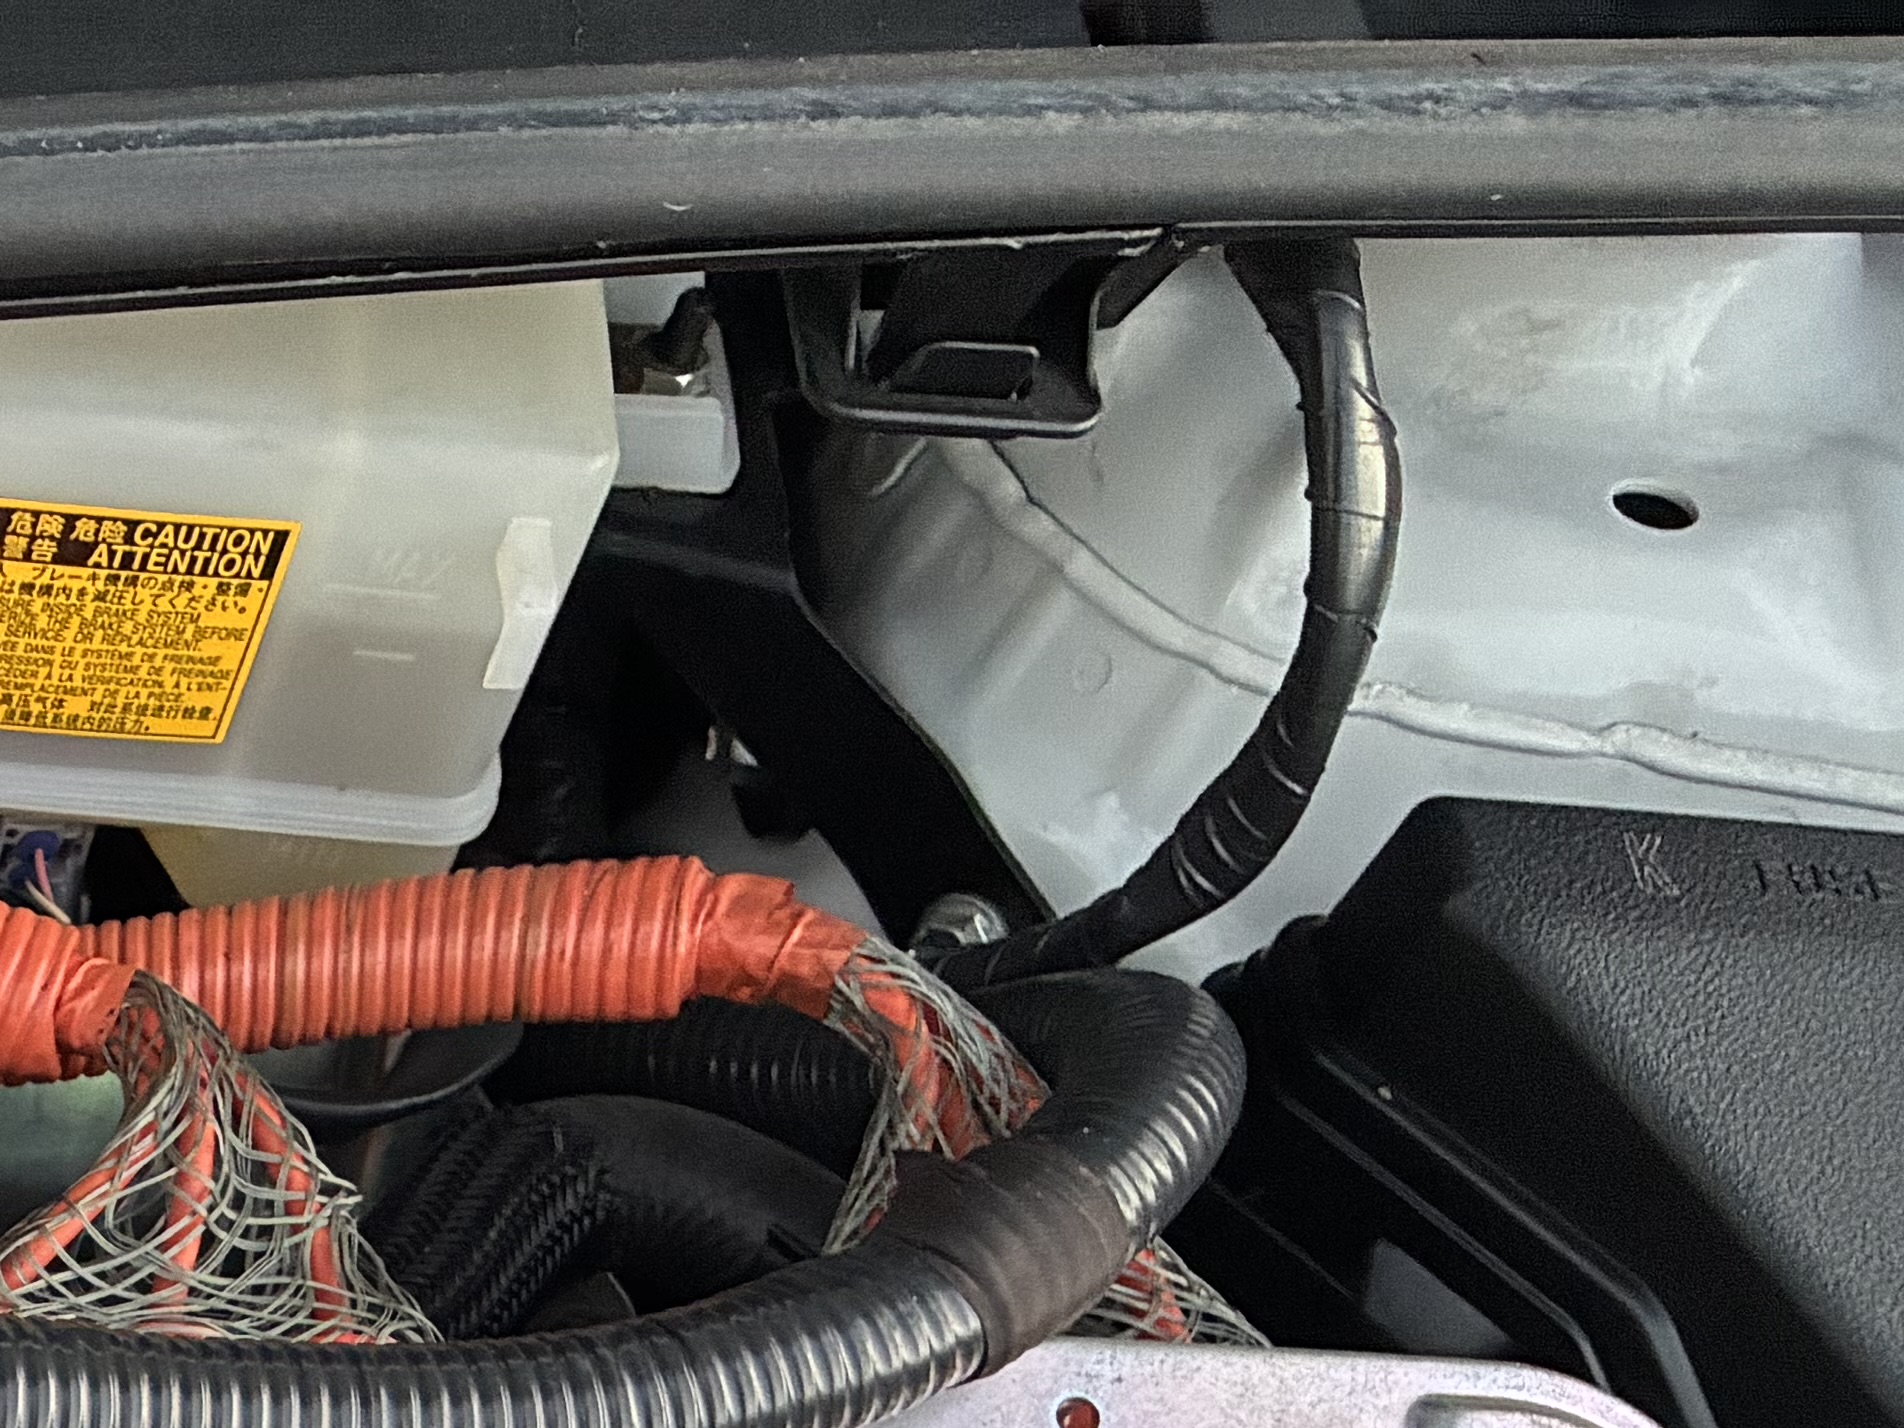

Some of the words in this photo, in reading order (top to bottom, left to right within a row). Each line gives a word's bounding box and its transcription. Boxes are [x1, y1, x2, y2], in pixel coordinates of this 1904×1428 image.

[6, 510, 65, 537] 危険
[133, 518, 274, 557] CAUTION
[3, 534, 58, 562] 警告
[87, 540, 267, 582] ATTENTION
[145, 609, 201, 624] SYSTEM
[77, 617, 128, 631] BRAKE
[130, 622, 189, 636] SYSTEM
[72, 631, 96, 642] OR
[62, 646, 78, 655] LE
[141, 652, 158, 662] DE
[58, 671, 75, 682] LA
[146, 665, 164, 675] DE
[103, 688, 120, 698] DE
[125, 690, 139, 699] LA
